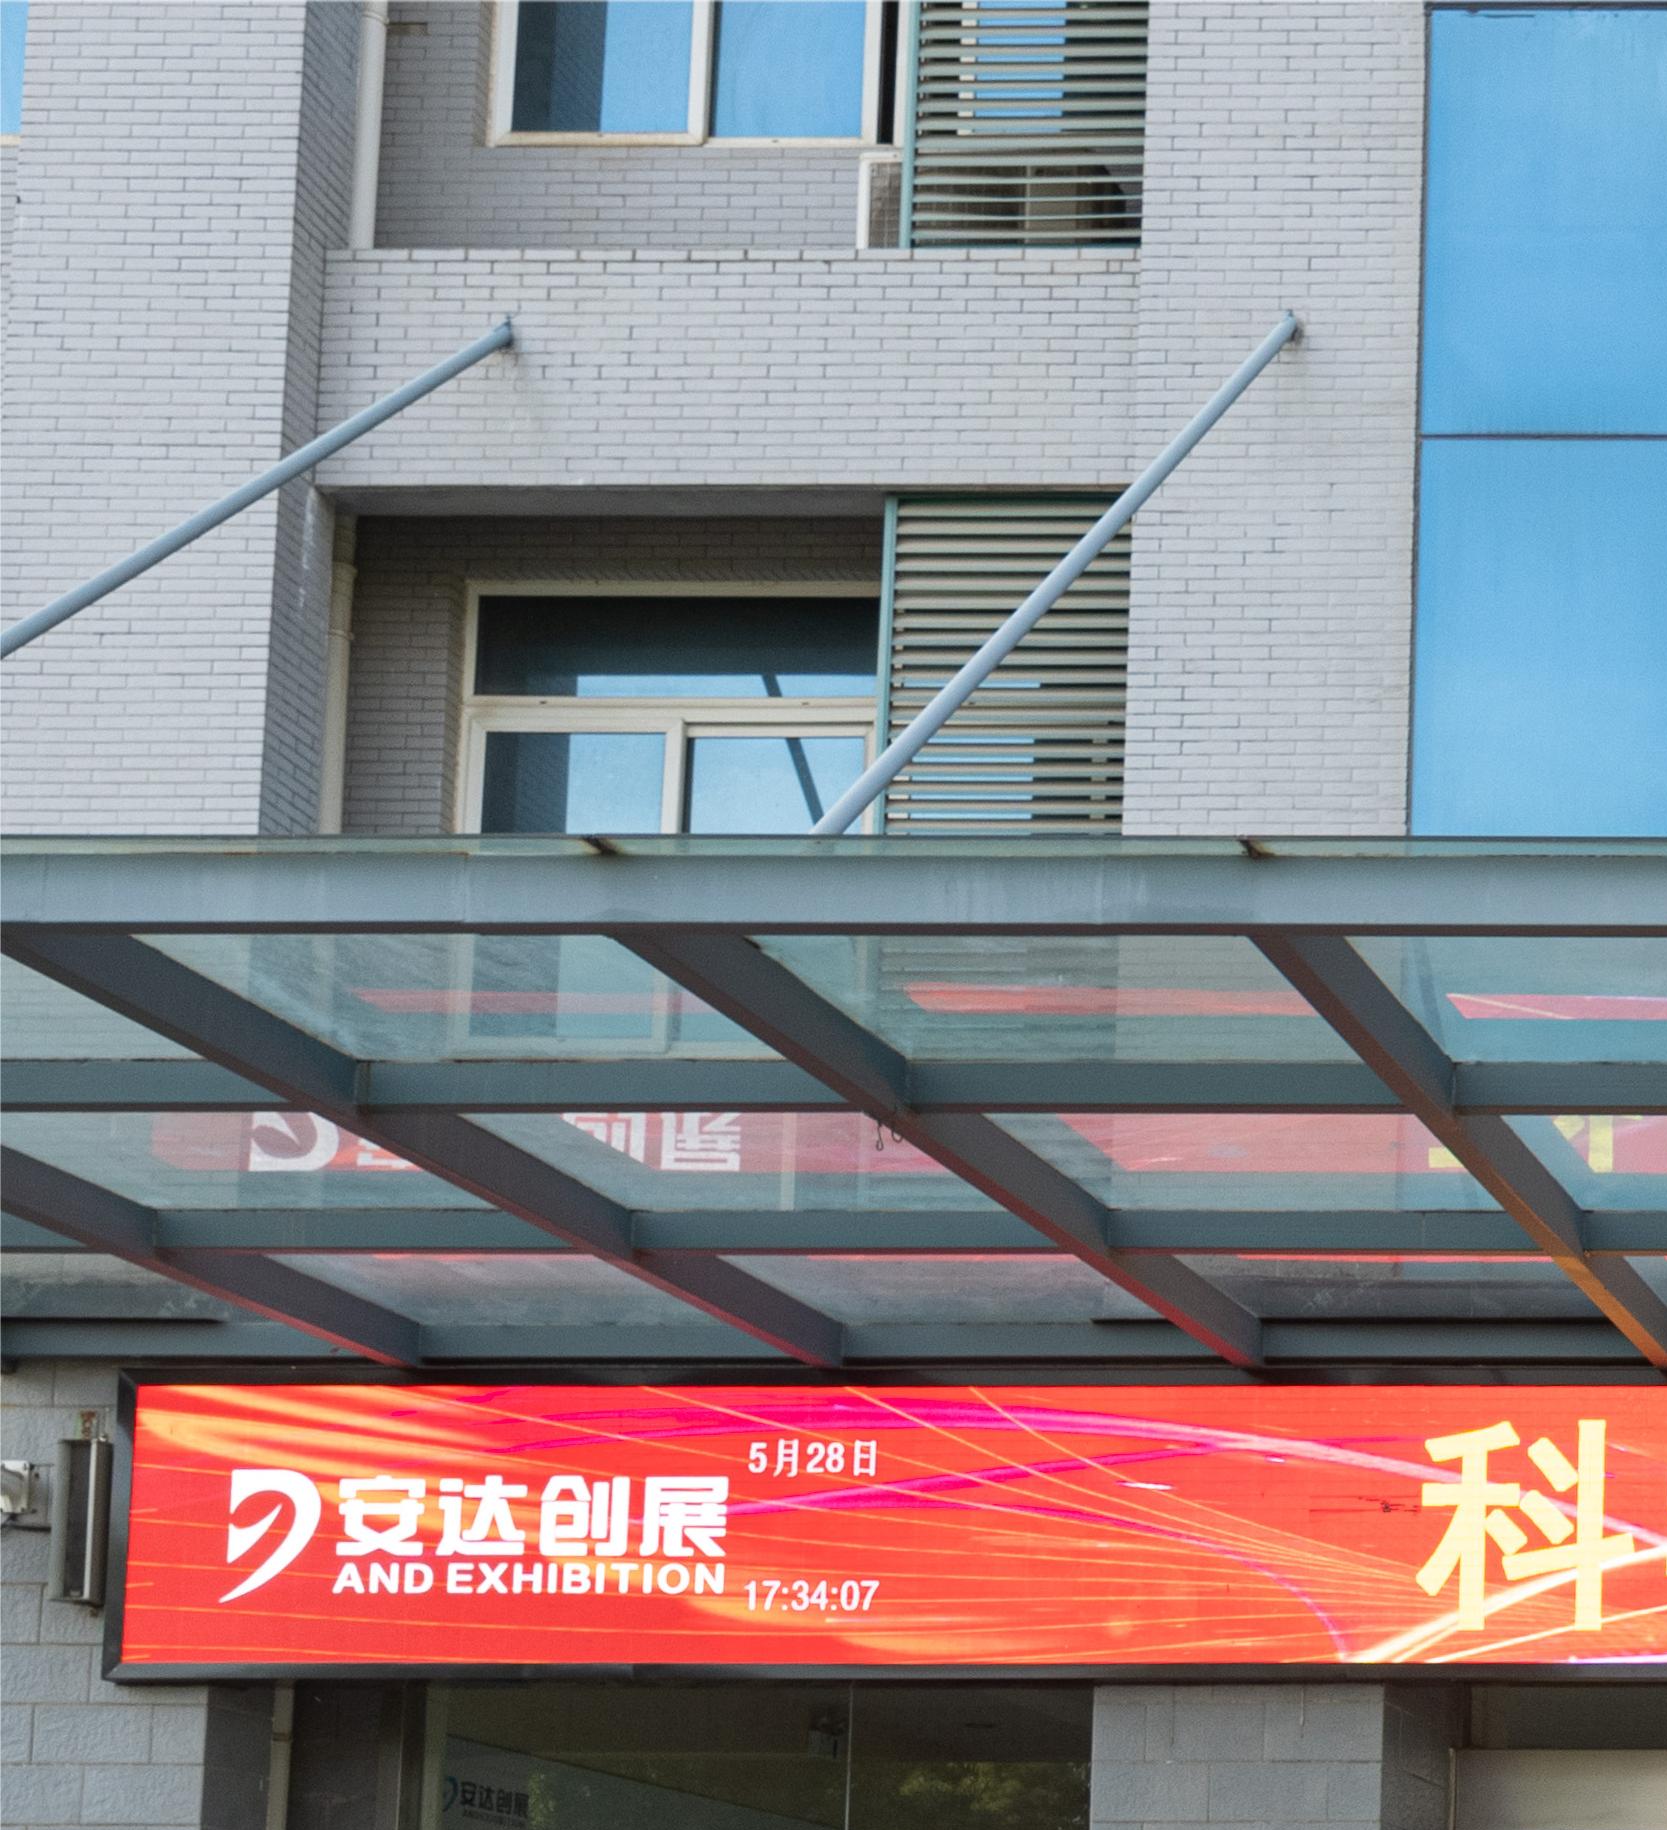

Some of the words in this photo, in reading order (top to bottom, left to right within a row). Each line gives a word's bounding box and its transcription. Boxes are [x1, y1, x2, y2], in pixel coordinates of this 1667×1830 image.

[748, 1439, 877, 1477] 5月28日
[335, 1474, 729, 1557] 安达创展
[332, 1562, 434, 1594] AND
[446, 1562, 726, 1594] EXHIBITION
[744, 1580, 880, 1611] 17:34:07
